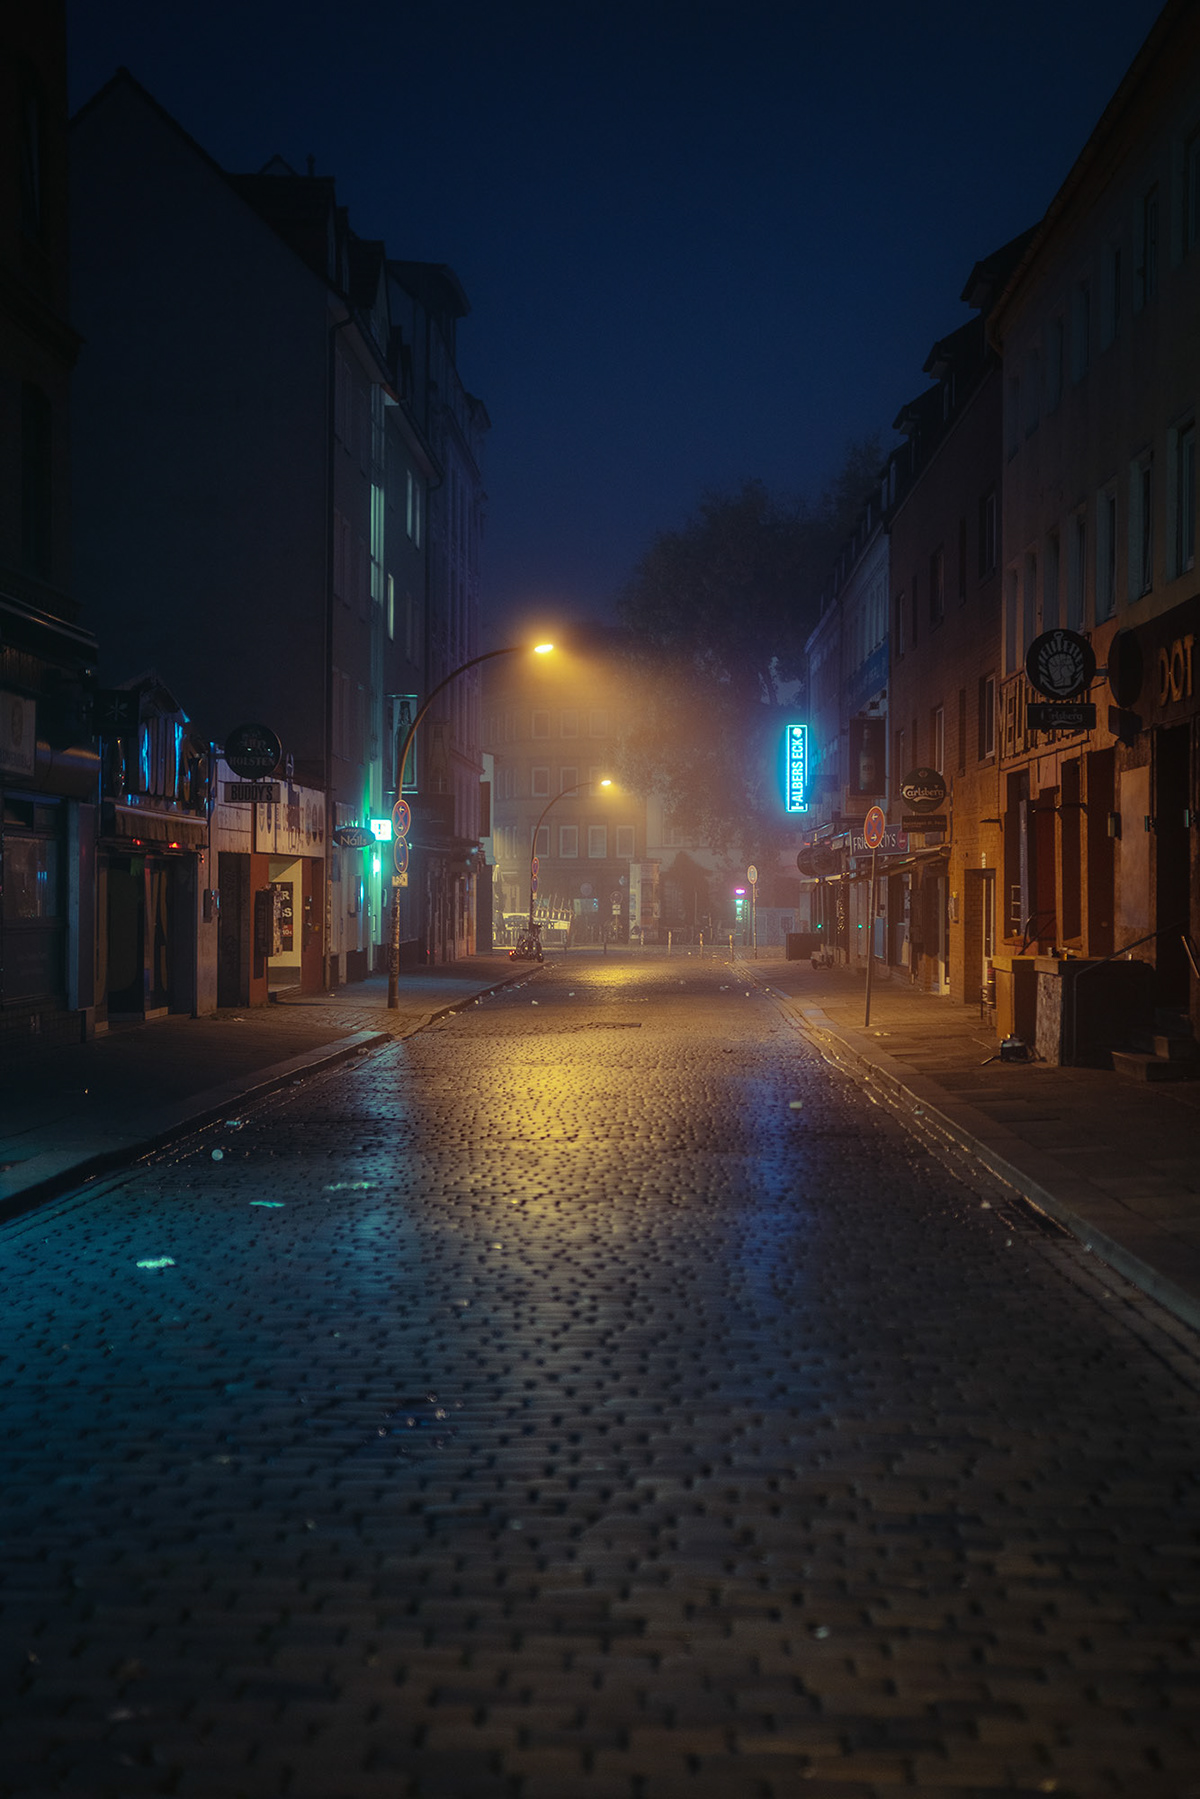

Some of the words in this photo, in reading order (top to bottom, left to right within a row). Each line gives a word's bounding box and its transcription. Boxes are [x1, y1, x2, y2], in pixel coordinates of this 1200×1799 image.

[791, 738, 804, 759] ECK
[791, 761, 804, 803] ALBERS
[231, 784, 273, 801] BUDDY'S
[902, 785, 944, 802] Carlsberg
